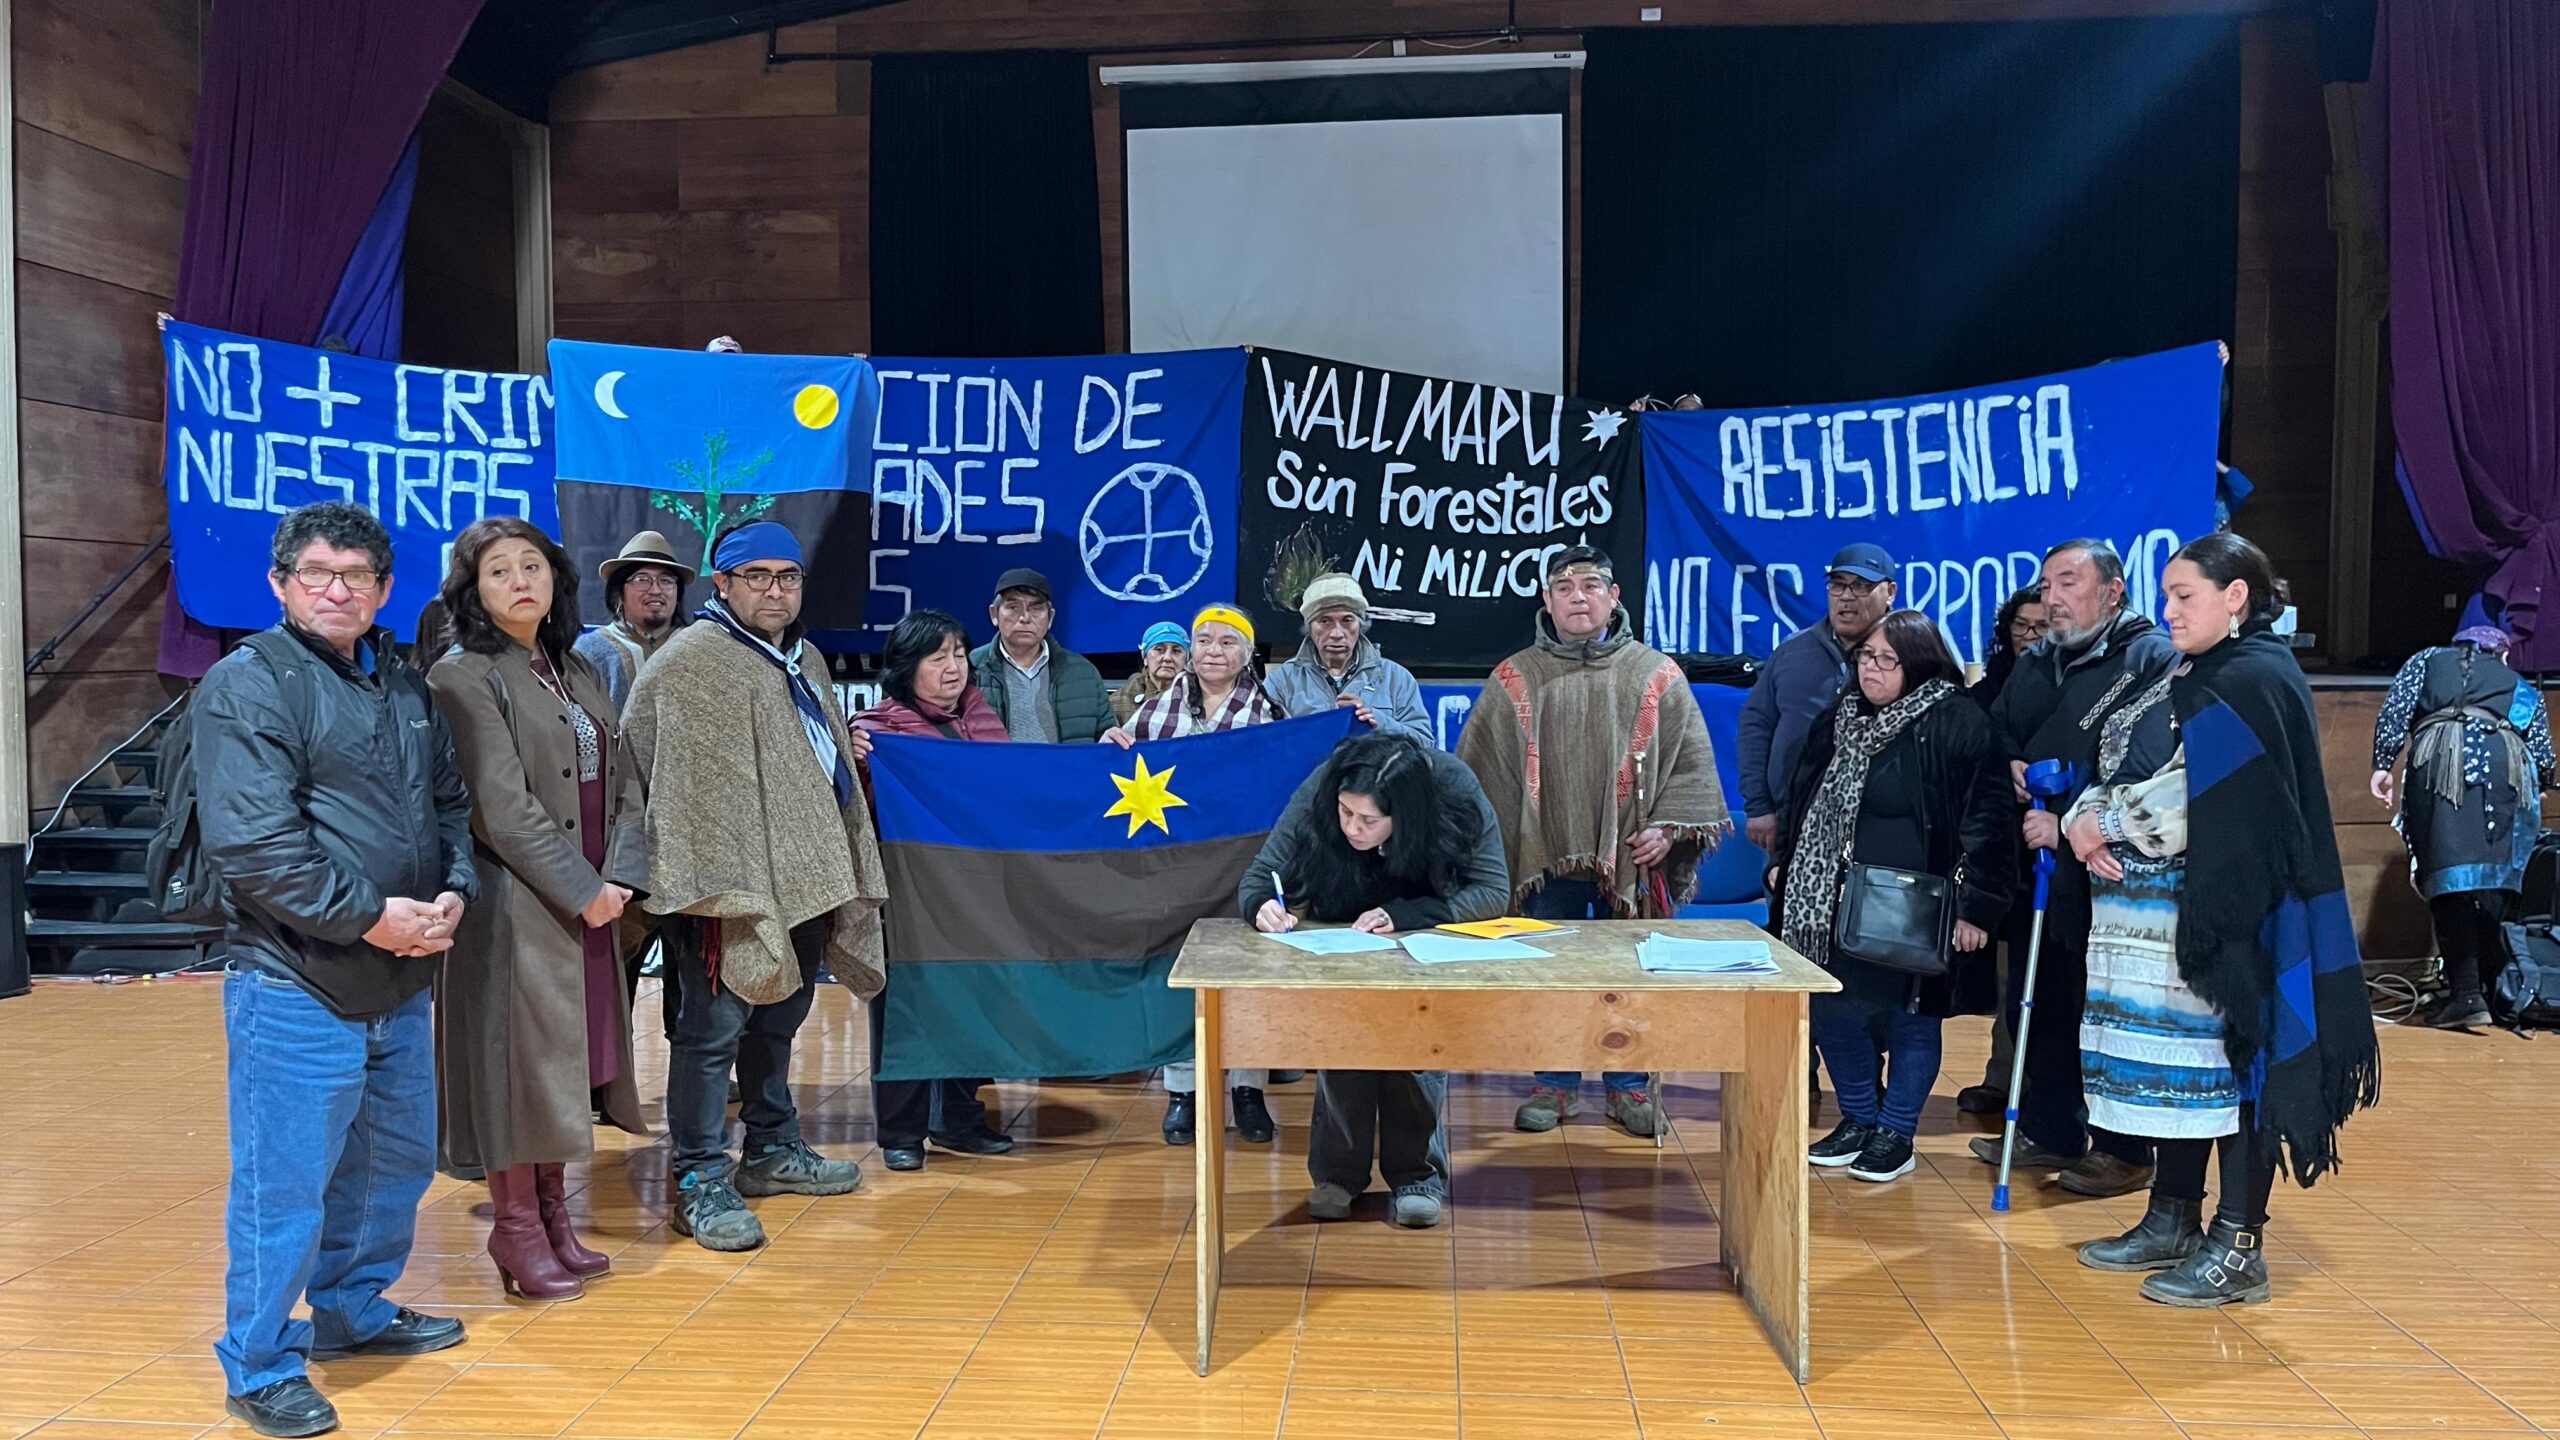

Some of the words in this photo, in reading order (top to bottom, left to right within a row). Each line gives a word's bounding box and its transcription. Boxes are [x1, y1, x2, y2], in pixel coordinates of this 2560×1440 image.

[172, 339, 263, 423] NO
[286, 356, 361, 429] +
[1074, 368, 1166, 455] DE
[1262, 356, 1565, 467] WALLMAPU
[178, 426, 534, 532] NUESTRAS
[1267, 450, 1357, 518] Sin
[1643, 556, 1711, 655] NO
